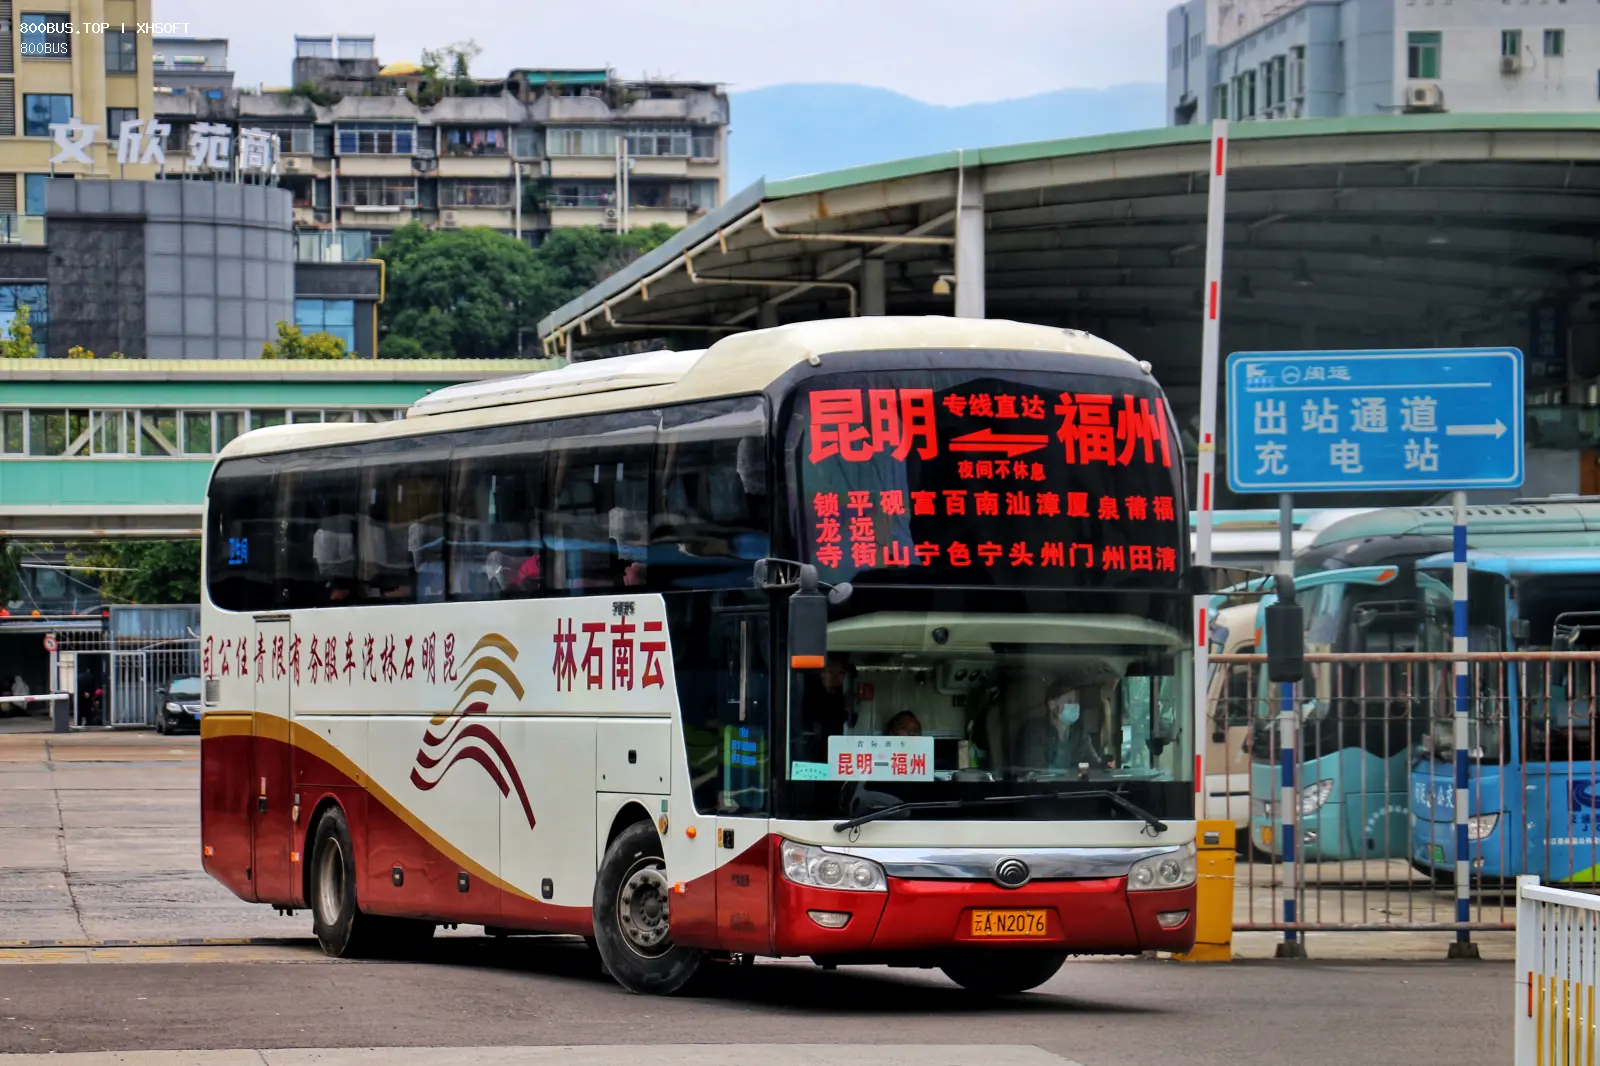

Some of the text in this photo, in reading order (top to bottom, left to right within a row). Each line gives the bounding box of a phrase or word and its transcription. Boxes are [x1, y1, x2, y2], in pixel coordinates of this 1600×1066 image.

[48, 117, 280, 174] 文欣苑商
[943, 393, 1046, 419] 专线直达
[1254, 396, 1438, 435] 出站通道
[808, 388, 938, 464] 昆明
[1054, 391, 1172, 468] 福州
[957, 460, 1047, 482] 夜间不休息
[1255, 437, 1439, 475] 充电站
